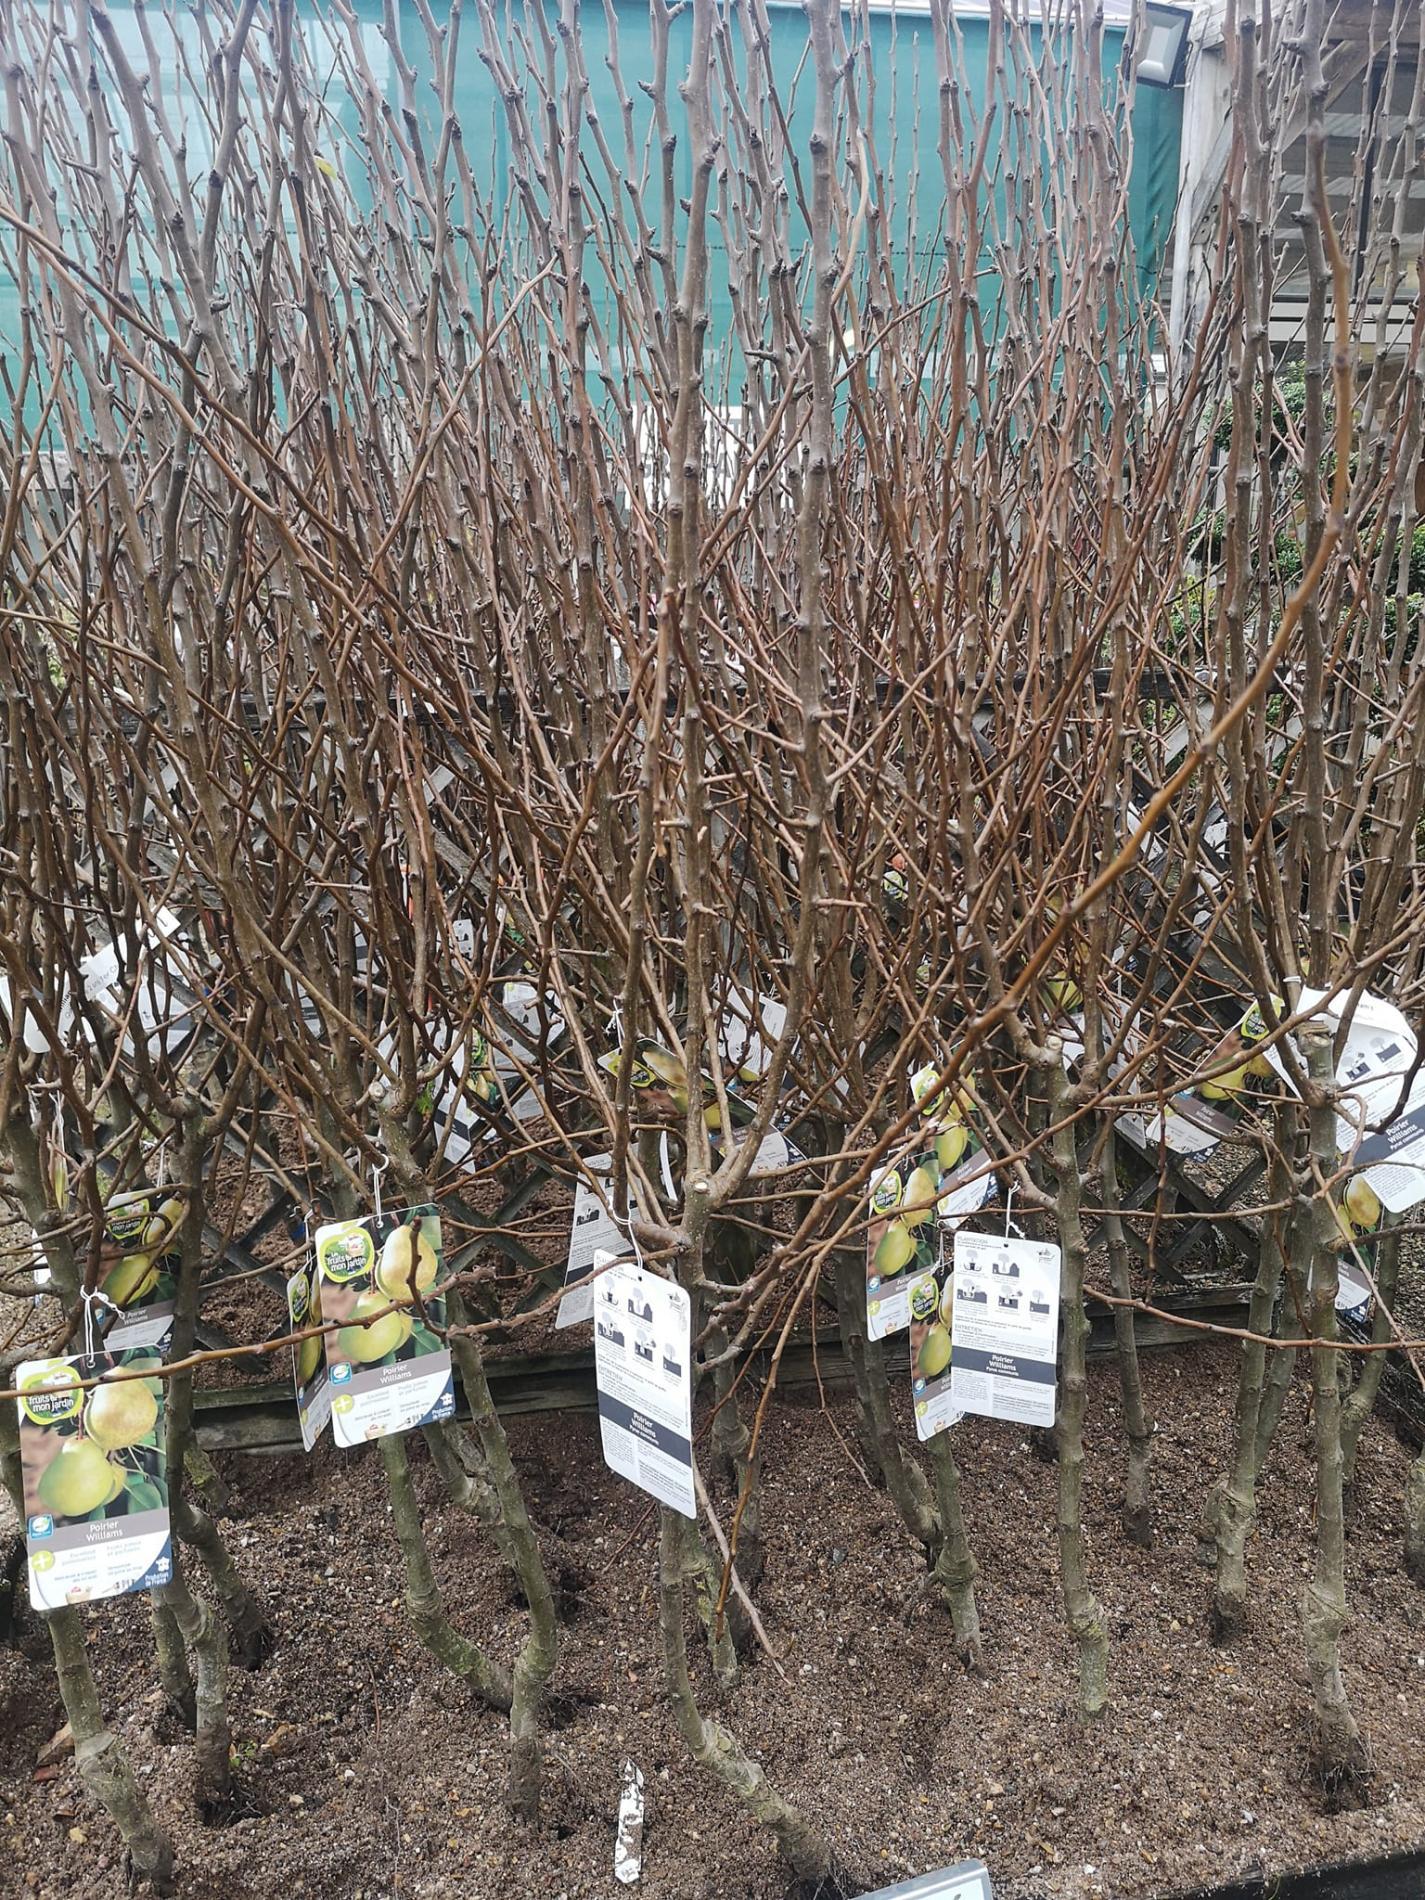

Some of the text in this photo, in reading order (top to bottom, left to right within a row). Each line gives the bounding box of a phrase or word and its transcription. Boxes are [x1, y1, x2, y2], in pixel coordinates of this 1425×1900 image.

[1385, 1119, 1410, 1137] Poirier
[1387, 1123, 1419, 1144] Williams
[327, 1254, 346, 1265] fruits
[330, 1256, 367, 1272] mon jardin
[122, 1307, 142, 1319] Poirier
[119, 1314, 149, 1327] Williams
[988, 1360, 1017, 1372] Williams
[991, 1354, 1014, 1365] Poirier
[382, 1364, 408, 1377] Poirier
[379, 1371, 413, 1385] Williams
[28, 1393, 51, 1405] fruits
[32, 1398, 74, 1412] mon jardin
[632, 1411, 654, 1428] Poirier
[631, 1418, 657, 1439] Williams
[89, 1520, 119, 1533] Poirier
[85, 1528, 124, 1542] Williams
